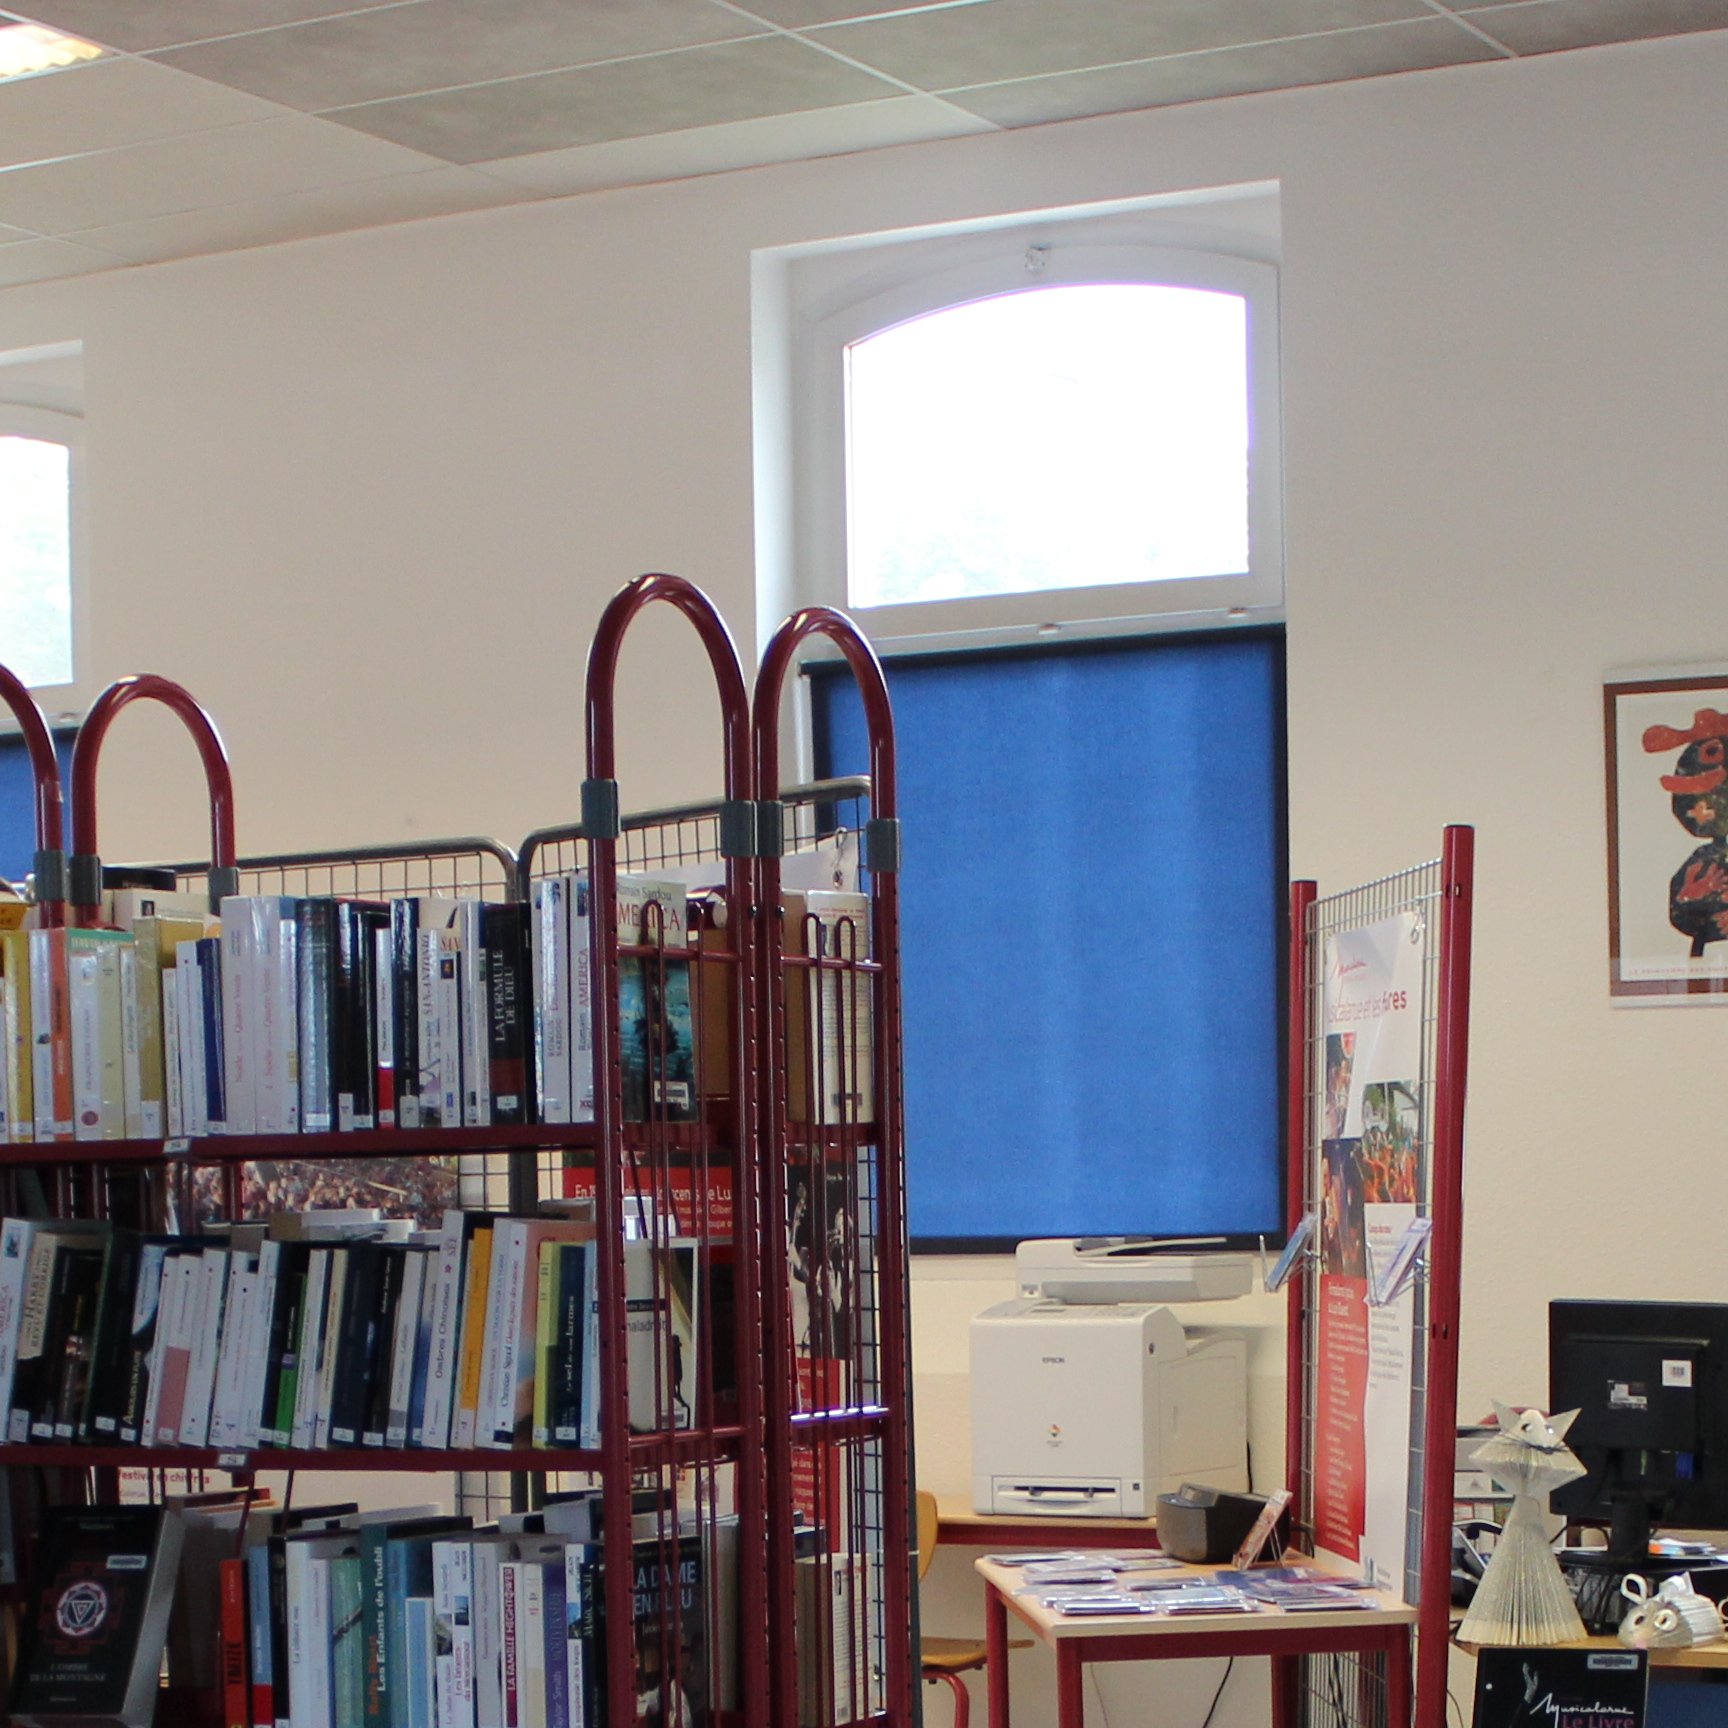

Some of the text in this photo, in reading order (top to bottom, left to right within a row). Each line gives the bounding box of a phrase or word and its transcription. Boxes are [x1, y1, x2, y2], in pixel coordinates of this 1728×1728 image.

[492, 949, 504, 1041] LA FORMULE
[504, 966, 516, 1024] DE DIEU
[577, 948, 588, 1008] AMERICA
[433, 1282, 450, 1380] Ombres Chinoises
[564, 1295, 576, 1337] larmes
[564, 1363, 575, 1380] sel
[1041, 1356, 1066, 1365] EPSON
[373, 1546, 387, 1692] Les Enfants de l'oubli
[503, 1634, 516, 1677] FAMILLE
[505, 1678, 517, 1691] LA
